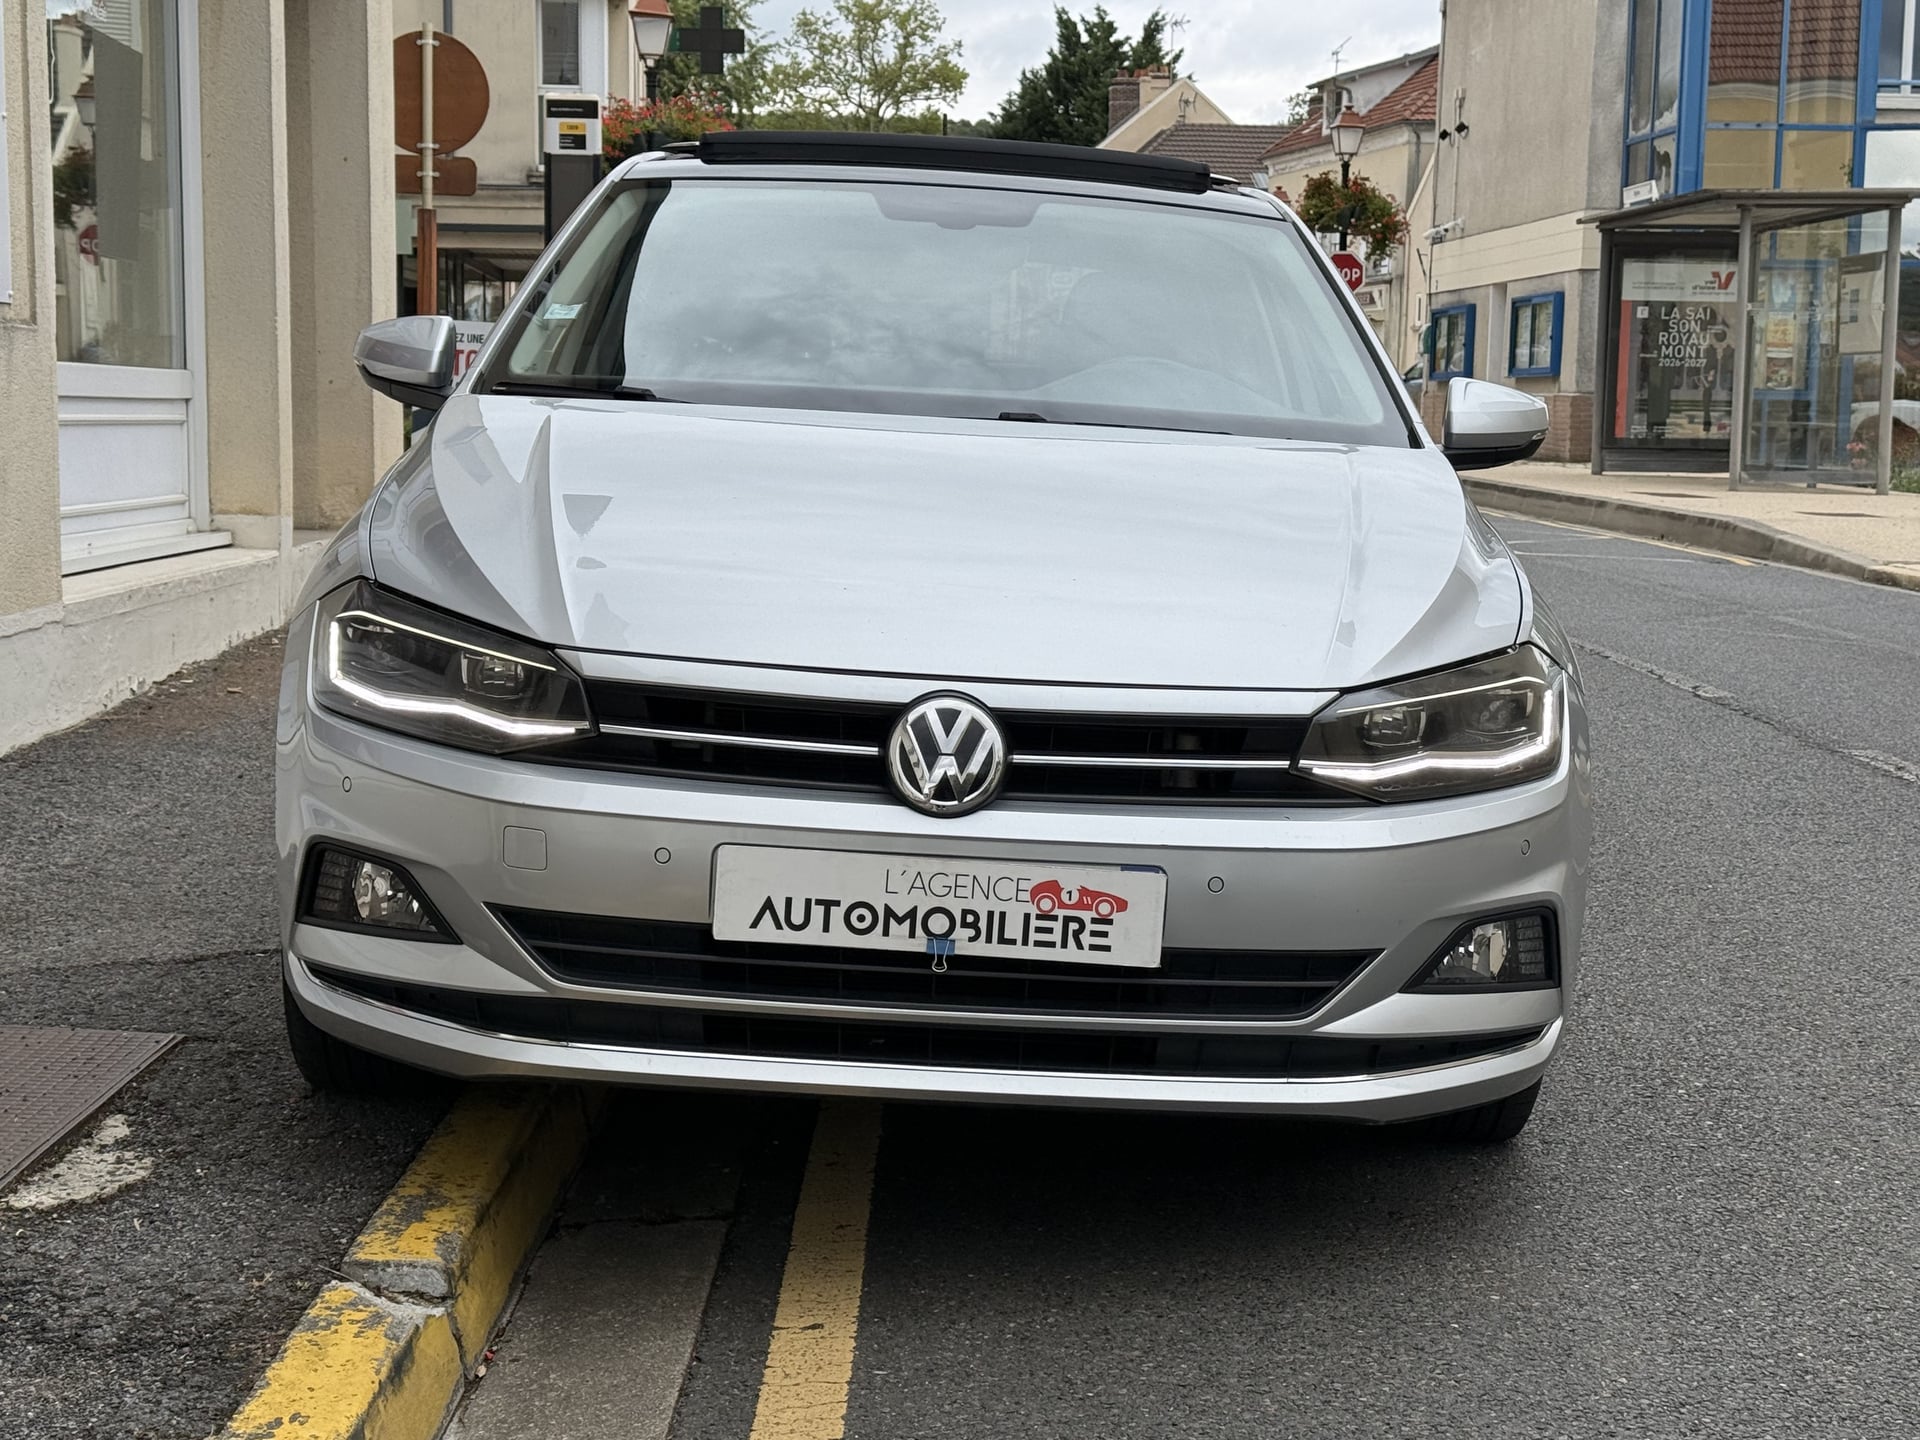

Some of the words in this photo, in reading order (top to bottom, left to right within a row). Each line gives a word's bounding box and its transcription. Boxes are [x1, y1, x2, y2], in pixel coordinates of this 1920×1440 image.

[1341, 268, 1361, 282] OP
[1661, 306, 1680, 320] LA
[1686, 306, 1710, 320] SAI
[1669, 320, 1700, 333] SON
[467, 333, 485, 344] UNE
[1659, 332, 1709, 345] ROYAU
[1661, 345, 1707, 358] MONT
[1658, 358, 1707, 368] 2026-2027
[884, 868, 1032, 903] L'AGENCE
[1066, 890, 1073, 901] 1
[748, 895, 1114, 953] AUTOMOBILIERE
